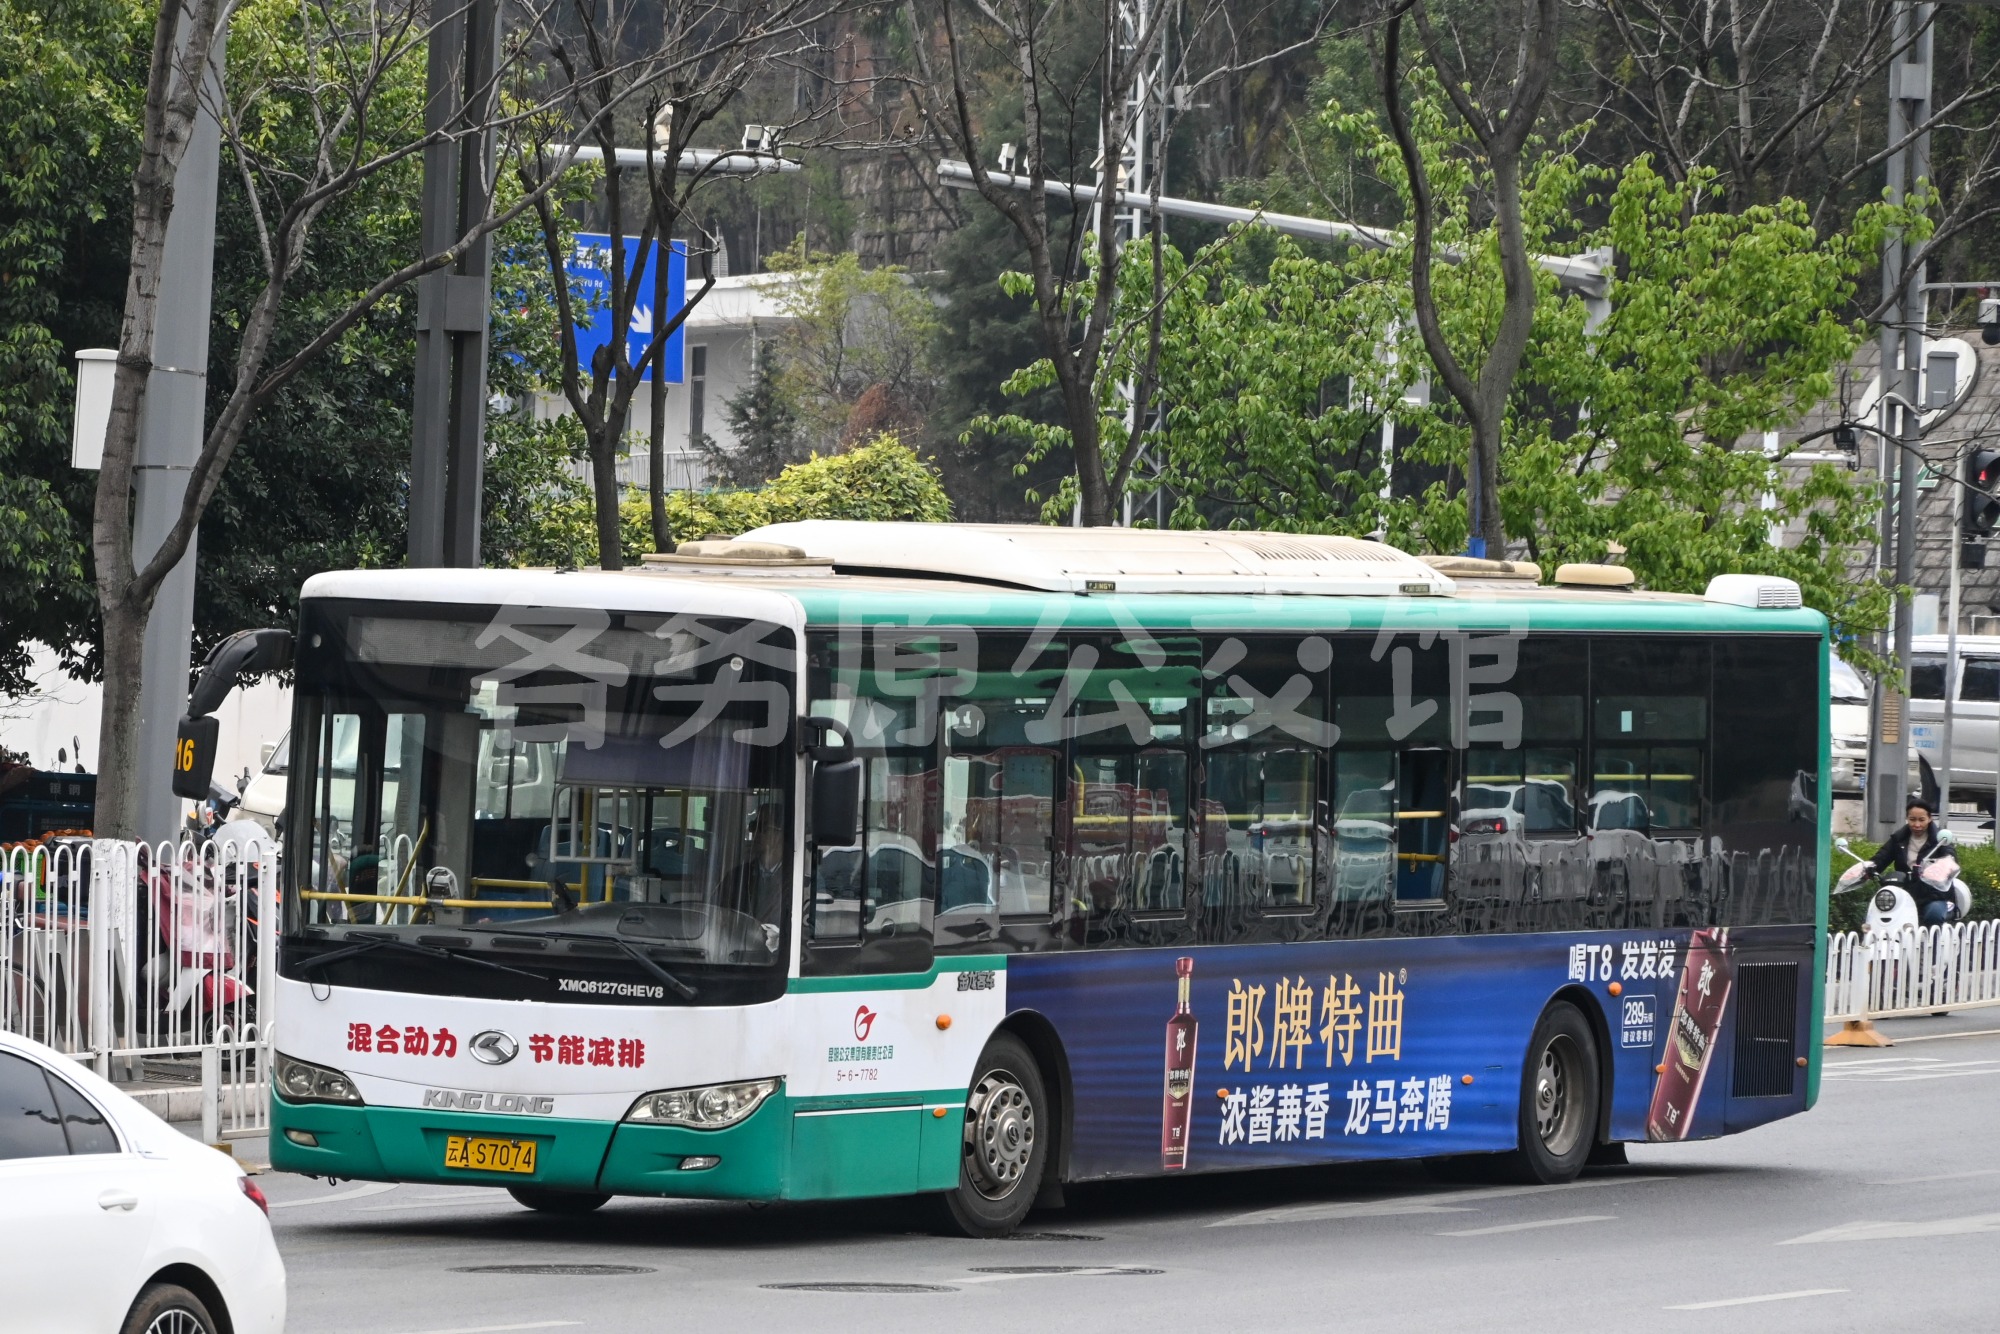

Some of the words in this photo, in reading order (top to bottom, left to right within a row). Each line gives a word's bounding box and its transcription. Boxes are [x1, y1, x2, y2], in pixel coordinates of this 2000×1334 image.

[175, 738, 195, 772] 16
[1568, 943, 1613, 982] 喝T8
[1620, 939, 1677, 981] 发发发
[558, 978, 664, 999] XMQ6127GHEV8
[957, 970, 996, 991] 金龙客车
[1223, 971, 1405, 1073] 郎牌特曲
[346, 1022, 458, 1058] 混合动力
[528, 1033, 646, 1069] 节能减排
[828, 1045, 894, 1063] 昆明公交集团有限责任公司
[422, 1089, 483, 1110] KING
[484, 1093, 555, 1115] LONG
[1218, 1081, 1330, 1146] 浓酱兼香
[1344, 1073, 1452, 1137] 龙马奔腾
